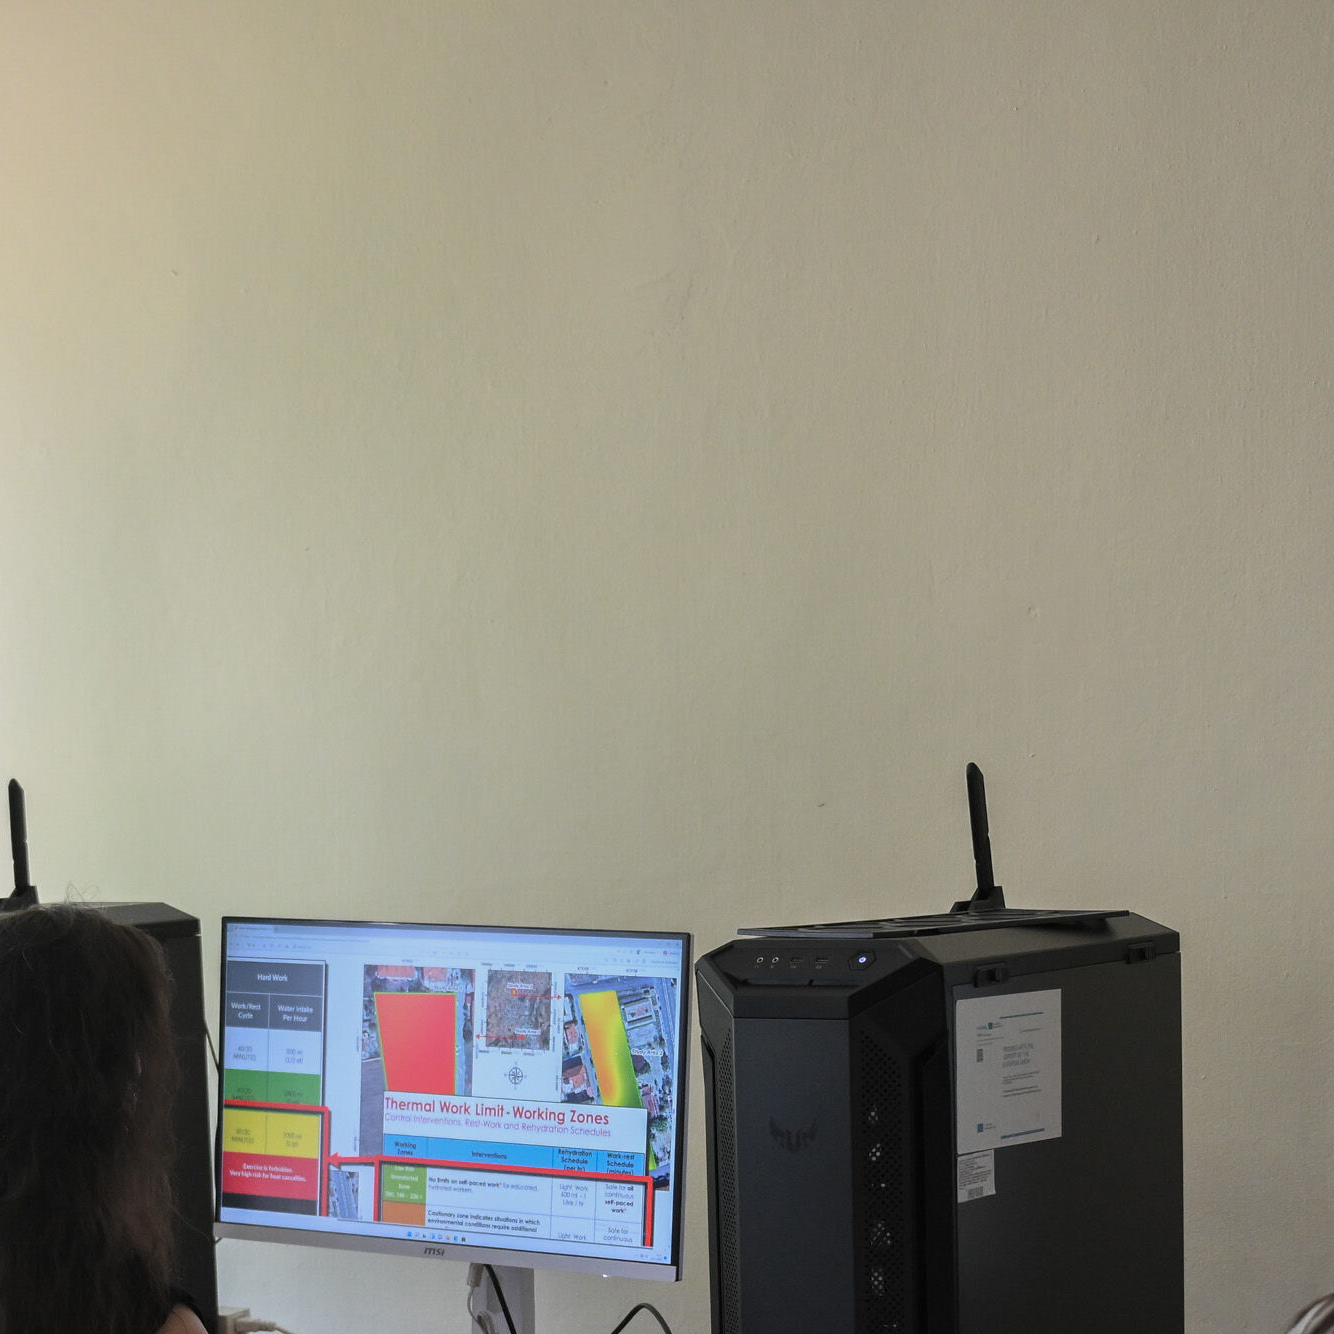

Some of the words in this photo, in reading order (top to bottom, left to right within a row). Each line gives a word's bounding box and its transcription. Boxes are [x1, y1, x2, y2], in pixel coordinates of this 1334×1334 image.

[384, 1097, 436, 1113] Thermal
[439, 1101, 471, 1116] Work
[475, 1103, 505, 1118] Limit
[512, 1106, 566, 1125] Working
[570, 1110, 610, 1125] Zones
[384, 1113, 412, 1122] Control
[503, 1121, 520, 1130] and
[521, 1123, 568, 1134] Rehydration
[570, 1127, 612, 1137] Schedules
[561, 1156, 589, 1165] Schedule
[607, 1160, 634, 1169] Schedule
